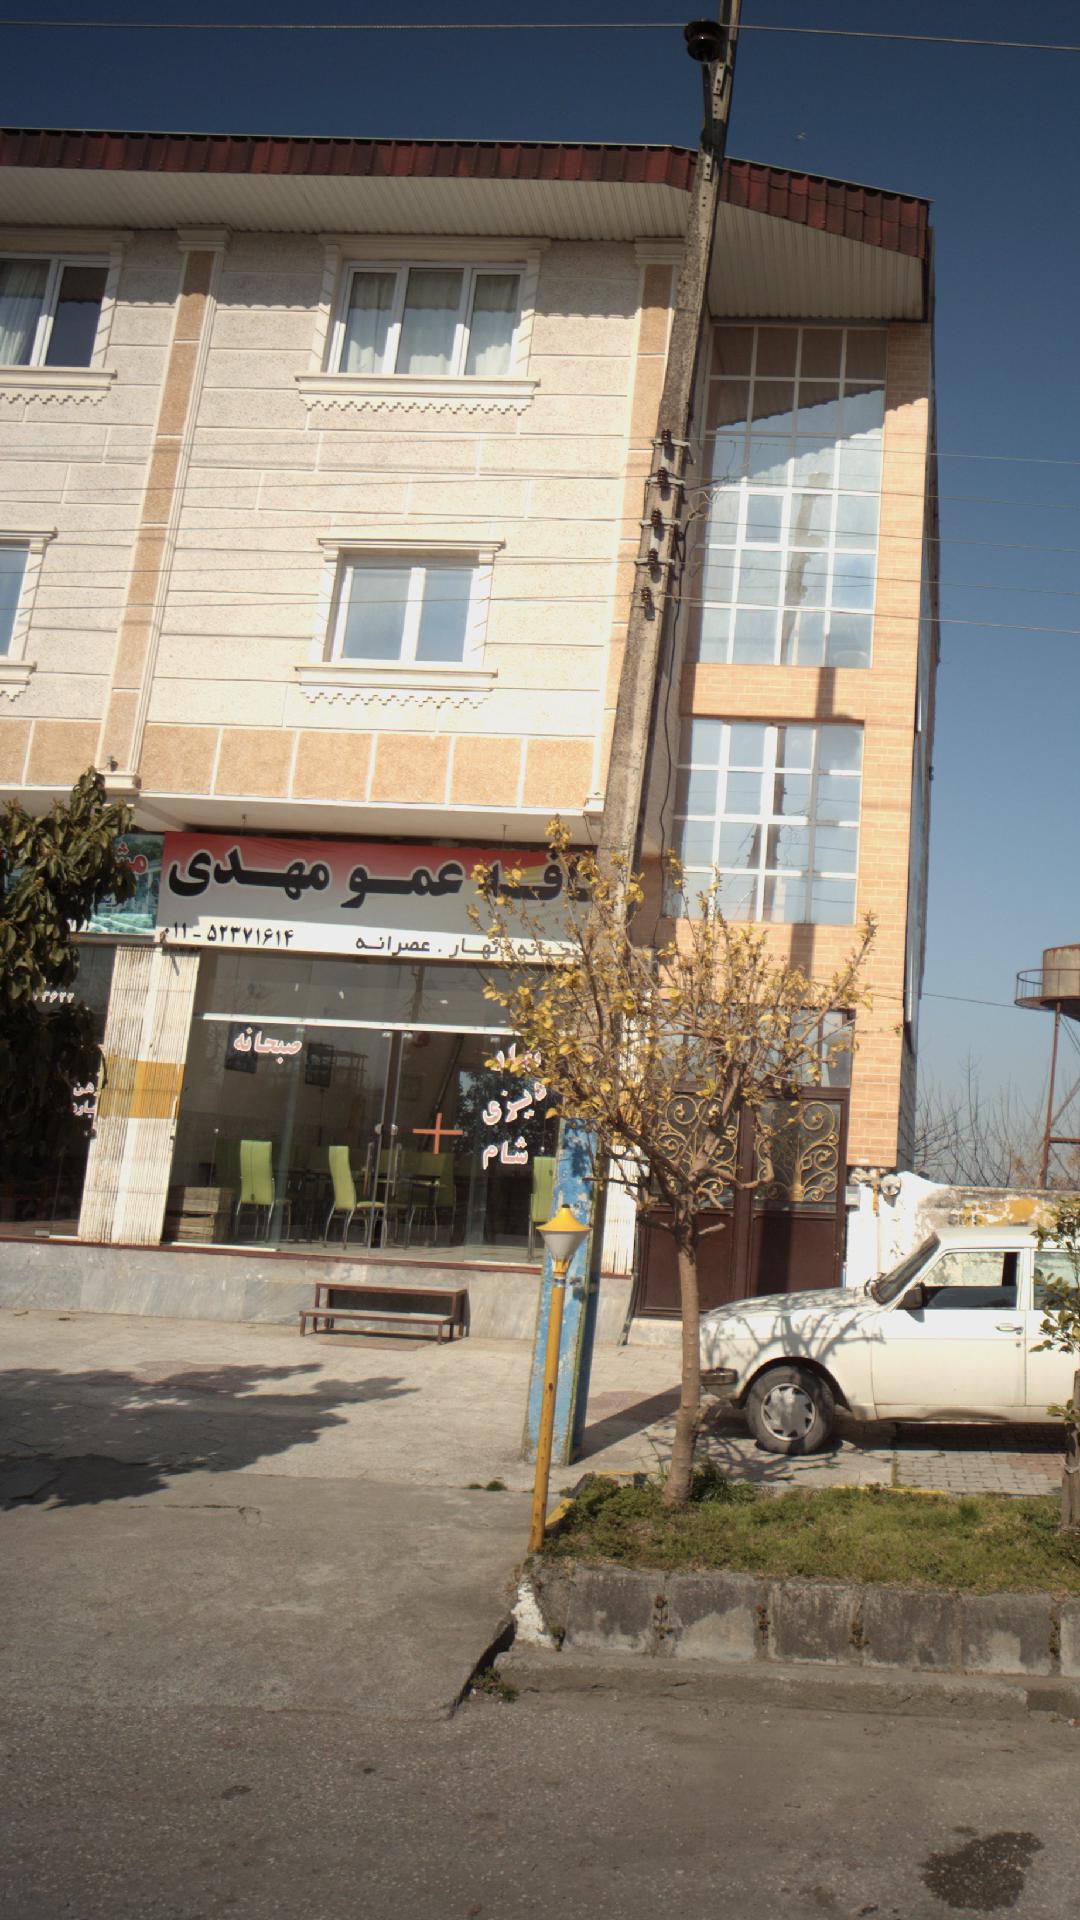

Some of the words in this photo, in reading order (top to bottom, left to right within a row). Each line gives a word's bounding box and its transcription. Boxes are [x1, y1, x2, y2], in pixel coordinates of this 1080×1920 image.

[169, 848, 329, 900] مهدی
[341, 863, 463, 908] عمو
[356, 936, 431, 957] عصرانه
[233, 1026, 303, 1065] صبحانه
[482, 1081, 547, 1126] دیزی
[482, 1135, 529, 1170] شام
